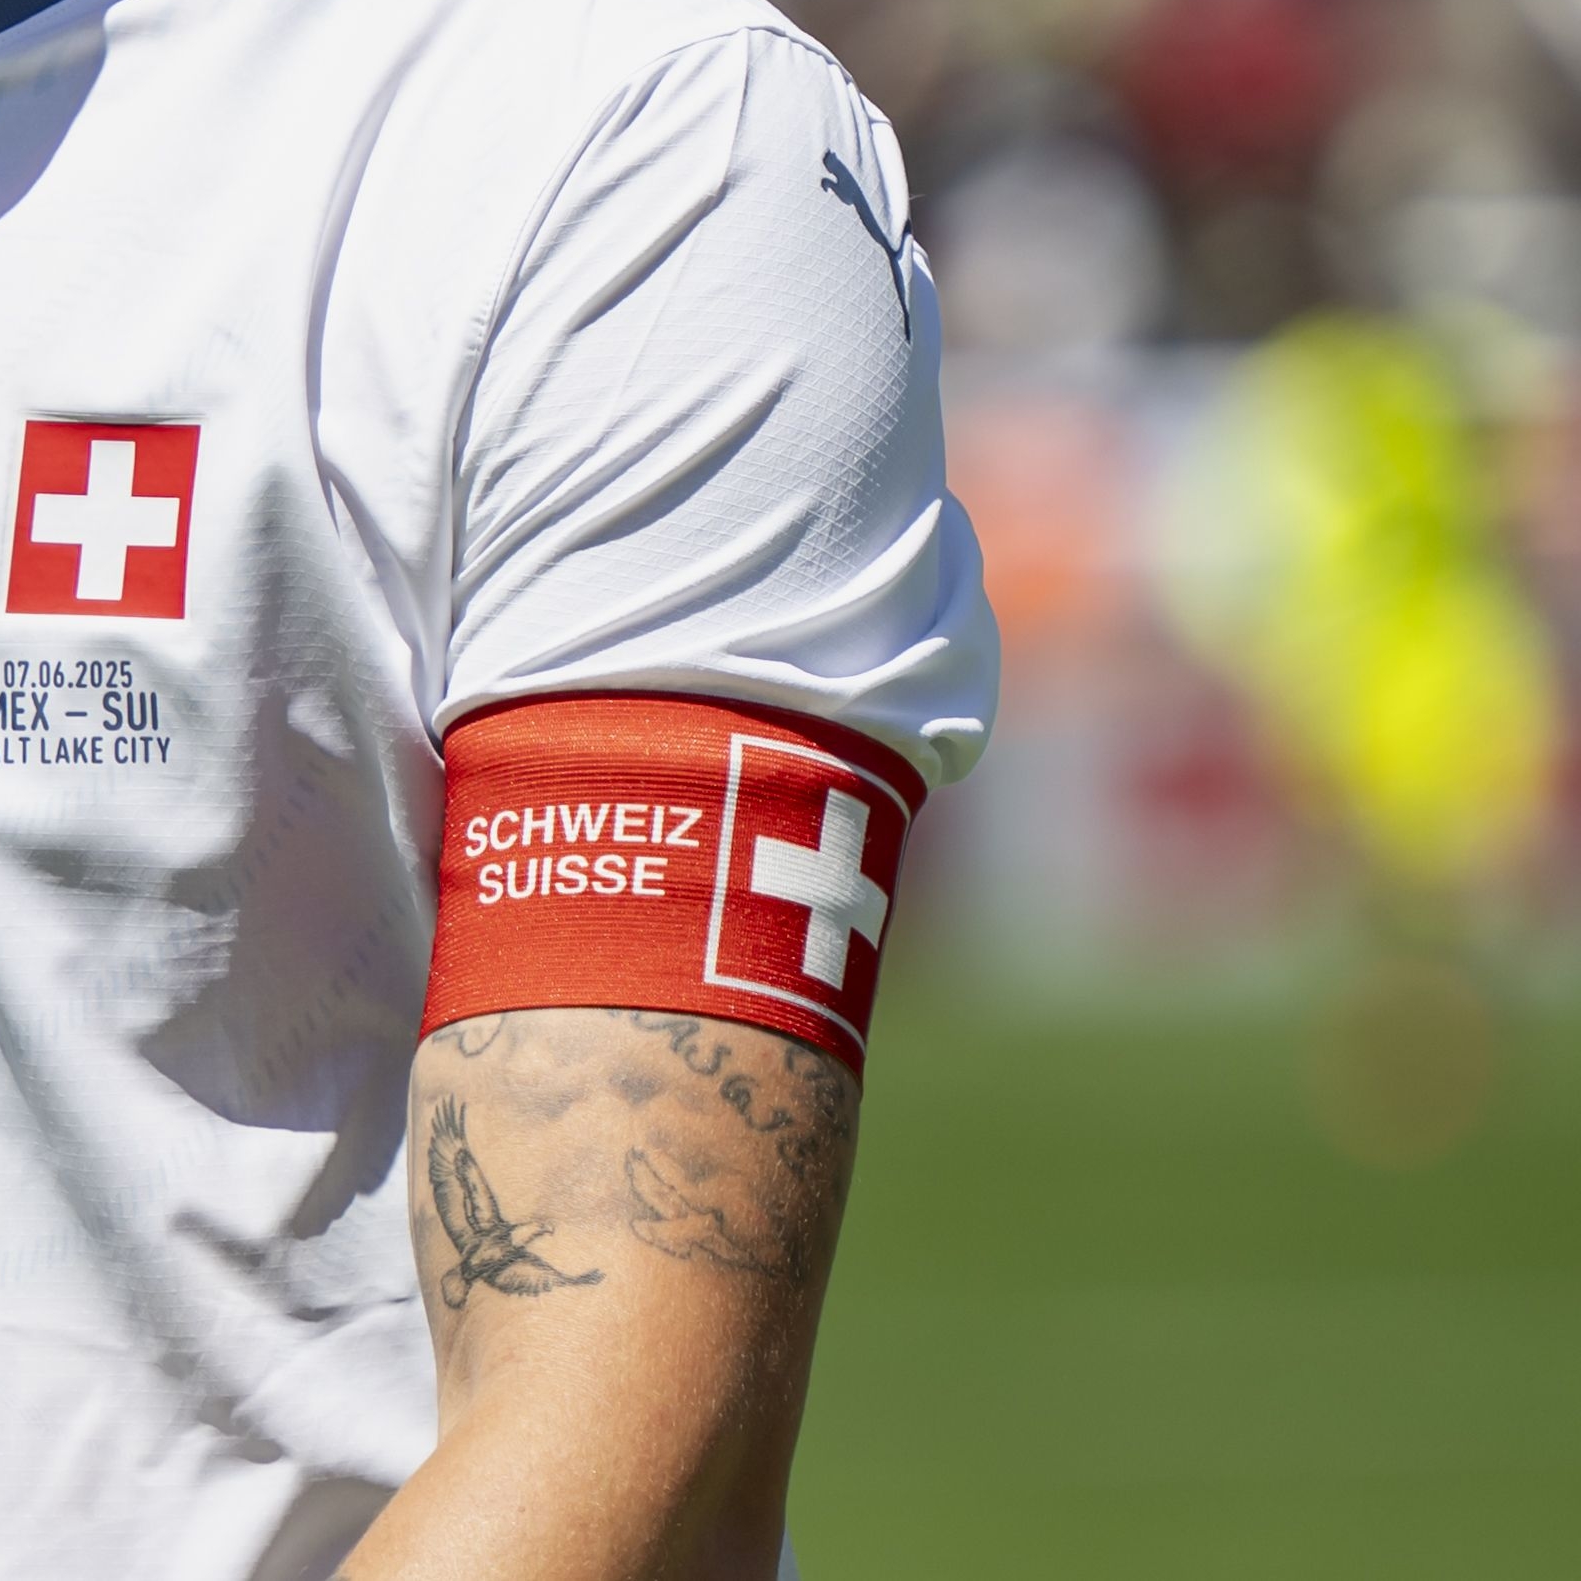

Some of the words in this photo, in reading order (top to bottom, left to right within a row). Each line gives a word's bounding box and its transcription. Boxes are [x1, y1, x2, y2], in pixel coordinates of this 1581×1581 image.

[3, 660, 133, 688] 07.06.2025
[102, 691, 159, 731] SUI
[40, 736, 103, 764] LAKE
[114, 736, 170, 764] CITY
[464, 802, 703, 857] SCHWEIZ
[478, 853, 668, 905] SUISSE
